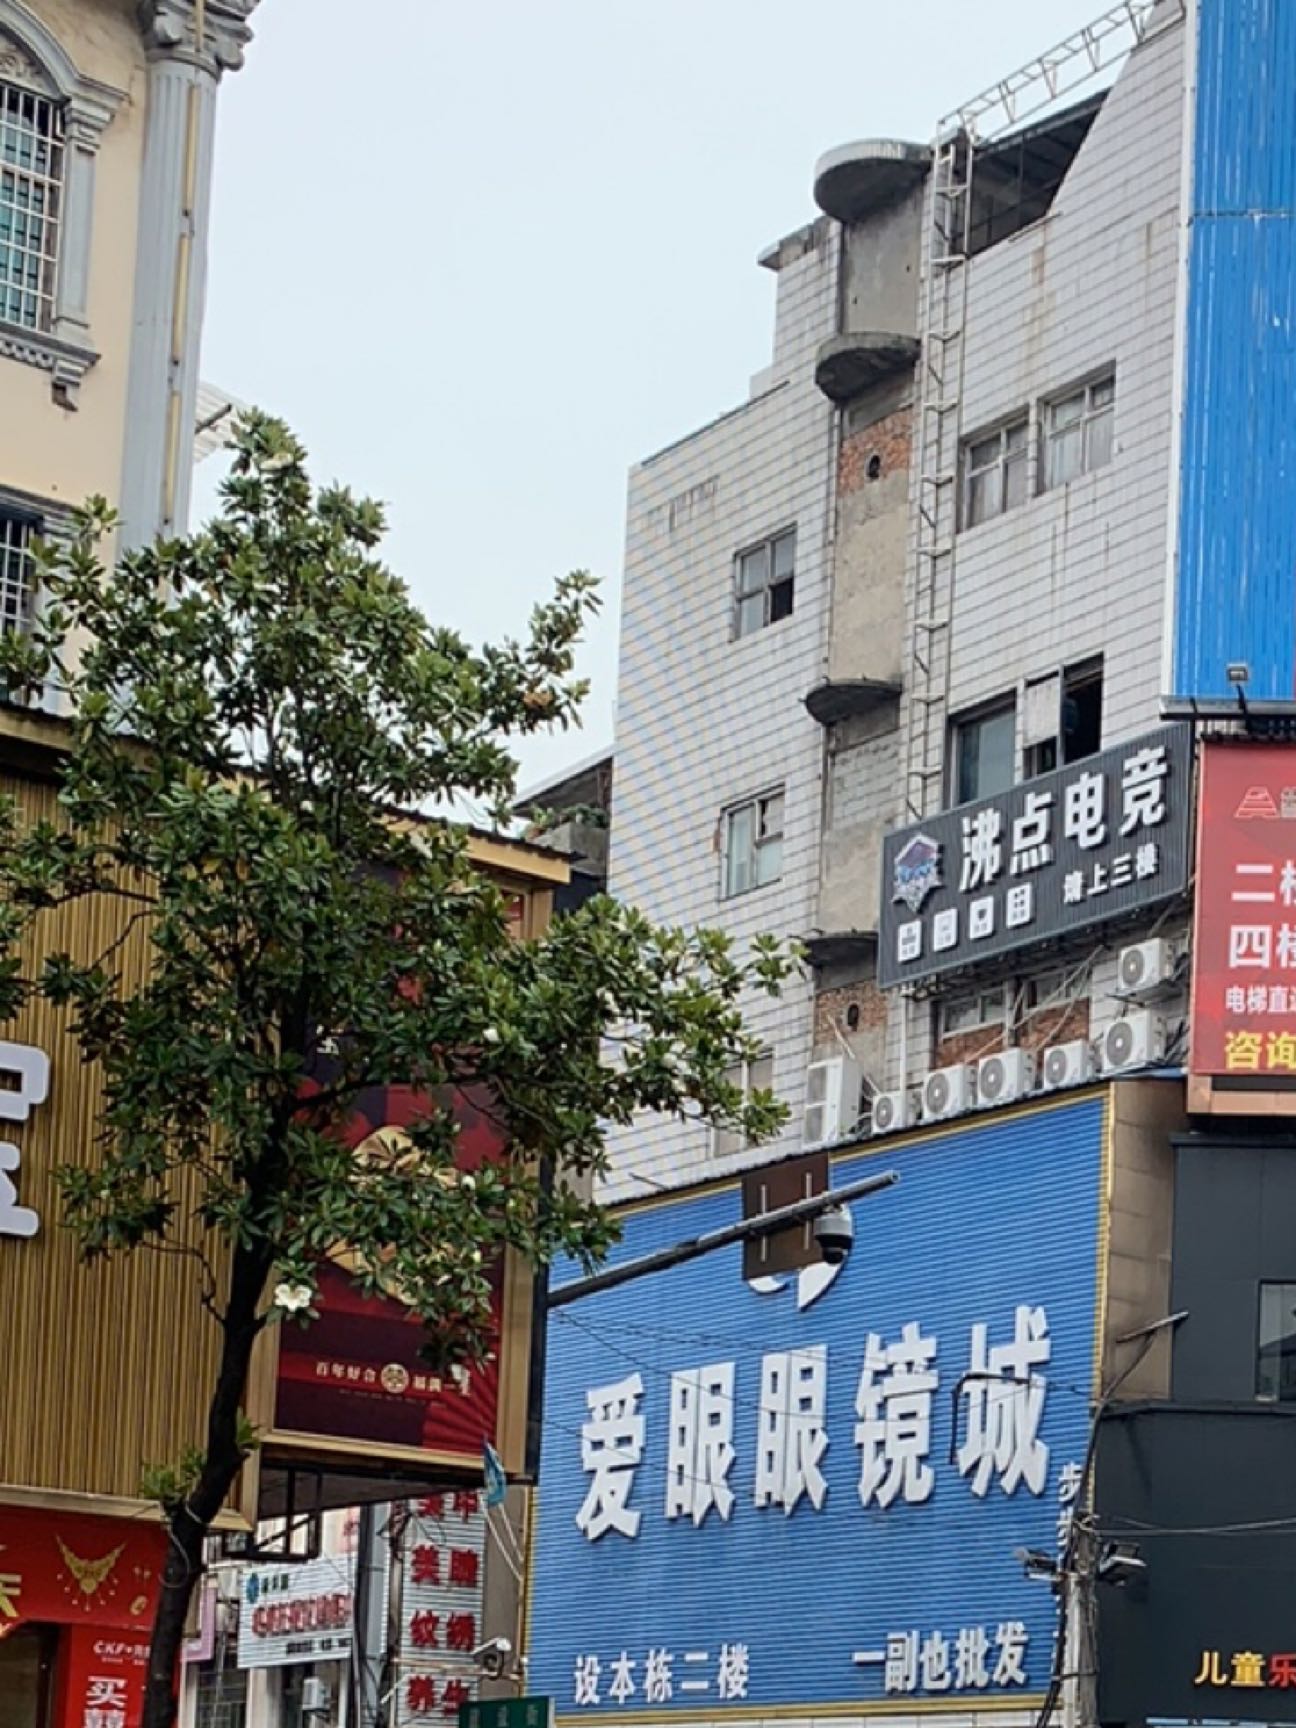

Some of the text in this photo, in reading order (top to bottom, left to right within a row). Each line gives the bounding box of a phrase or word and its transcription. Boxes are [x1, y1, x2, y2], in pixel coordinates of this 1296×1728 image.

[959, 744, 1169, 893] 沸点电竞
[574, 1304, 1052, 1542] 爱眼眼镜城
[573, 1641, 749, 1704] 设本栋二楼
[852, 1620, 1029, 1694] 一副也批发
